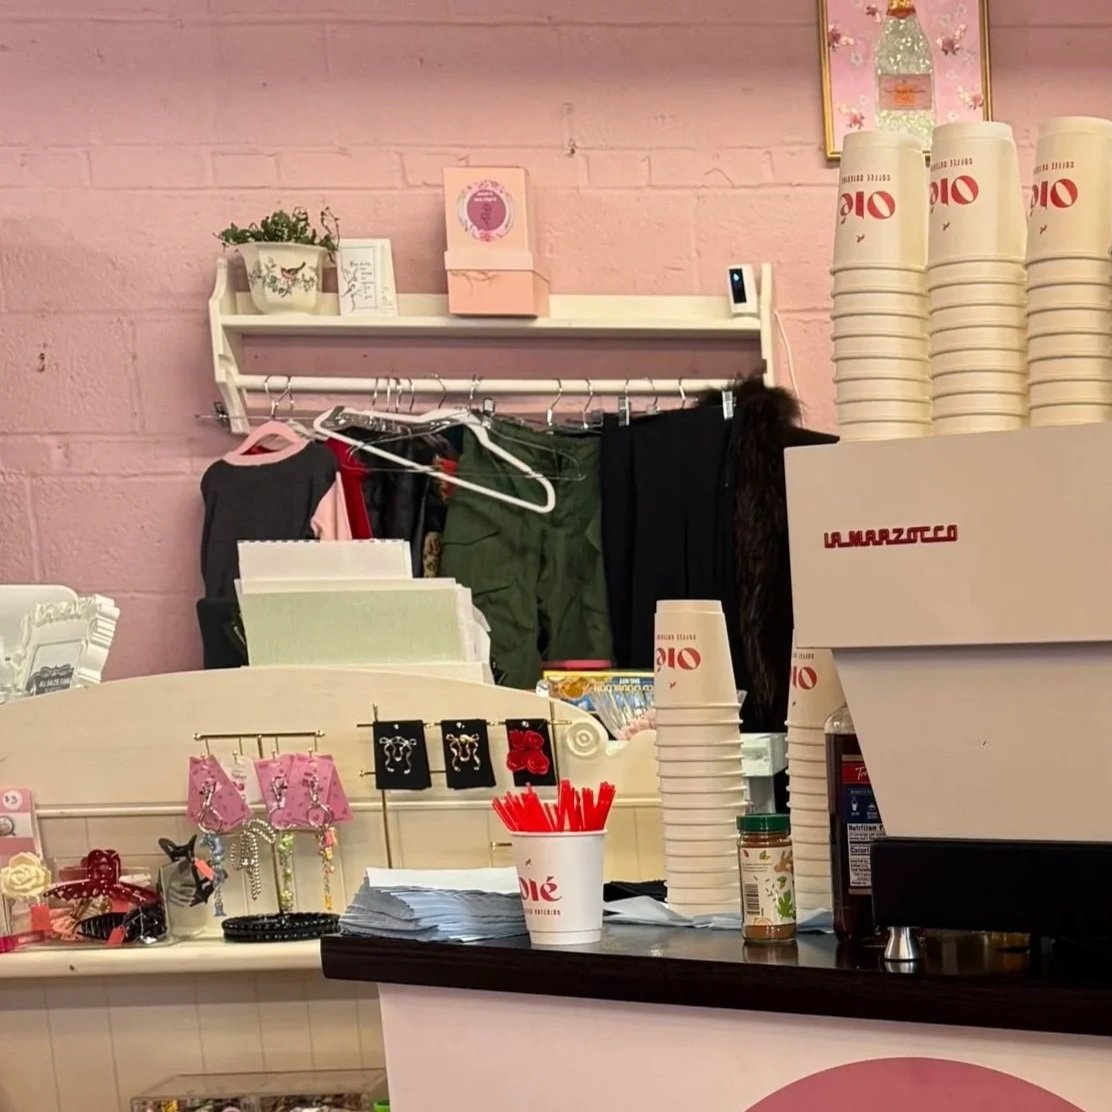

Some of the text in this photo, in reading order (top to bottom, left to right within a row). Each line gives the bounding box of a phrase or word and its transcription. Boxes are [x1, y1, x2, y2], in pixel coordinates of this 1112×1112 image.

[840, 190, 896, 224] Olé
[824, 525, 957, 549] LA MARZOCCO
[792, 666, 817, 690] Ol
